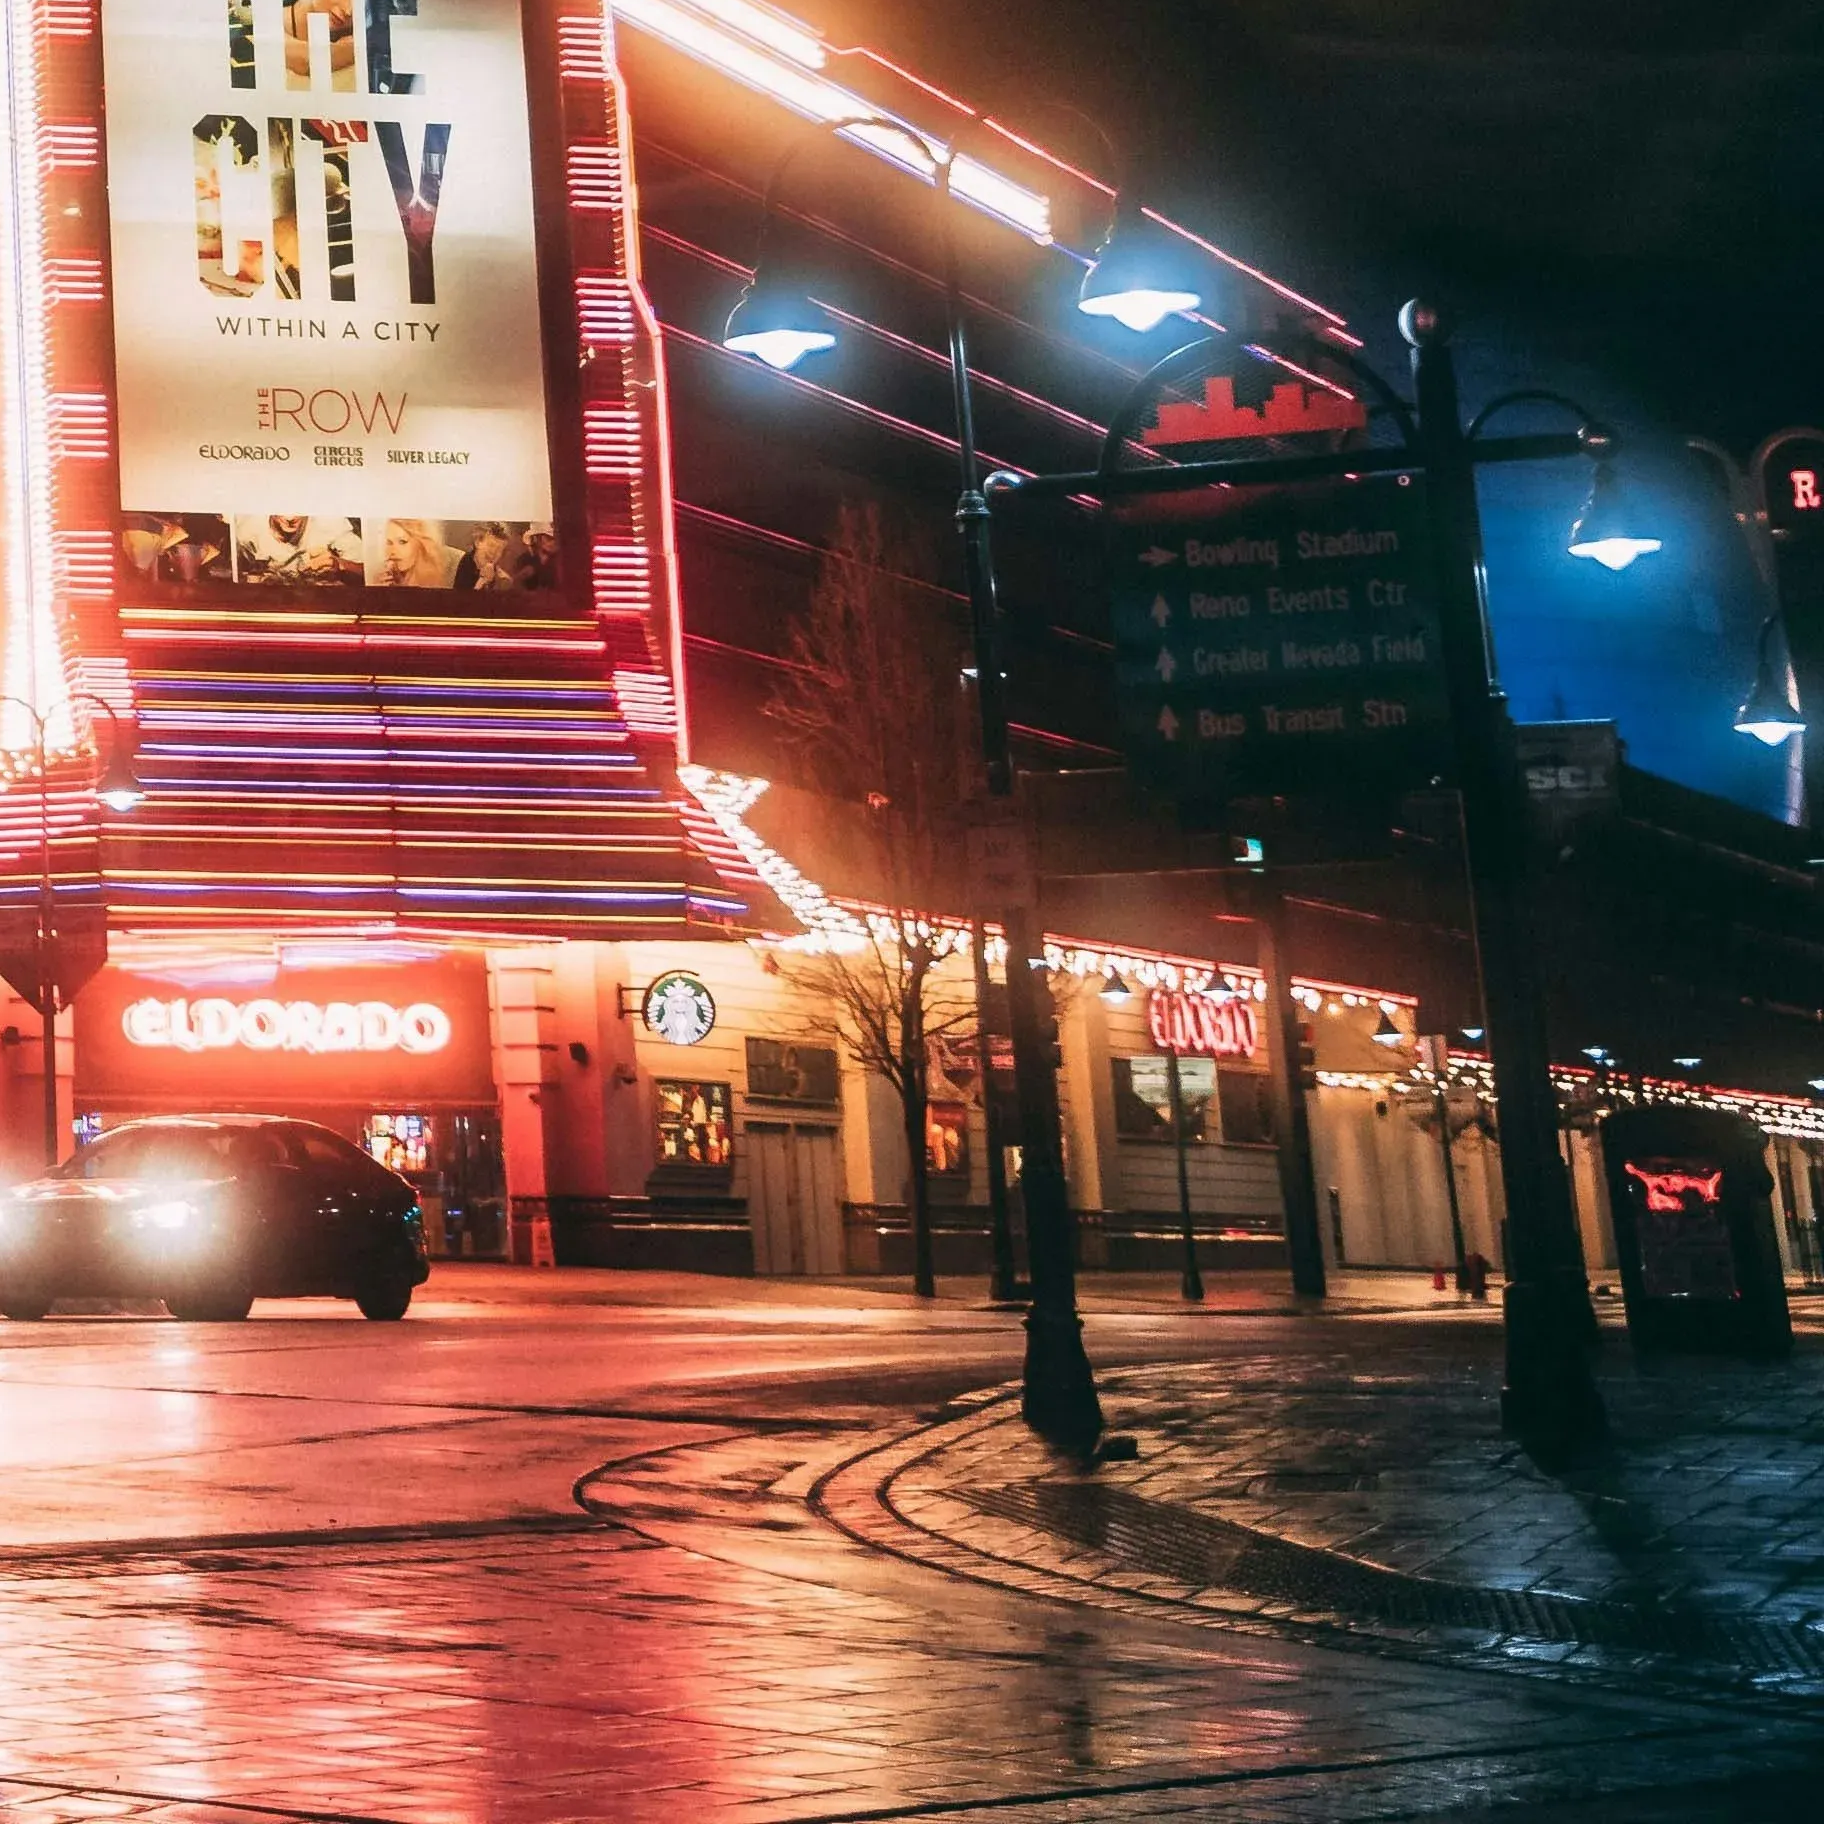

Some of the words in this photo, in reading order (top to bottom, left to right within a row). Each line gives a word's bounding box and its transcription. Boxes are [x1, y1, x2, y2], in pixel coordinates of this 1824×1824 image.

[193, 114, 452, 305] CITY
[216, 316, 326, 339] WITHIN
[342, 322, 359, 339] A
[374, 322, 441, 343] CITY
[257, 388, 270, 430] THE
[271, 388, 408, 435] ROW
[199, 444, 290, 462] ELDORADO
[313, 445, 364, 457] CIRCUS
[314, 456, 364, 467] CIRCUS
[387, 449, 424, 464] SILVER
[428, 452, 470, 465] LEGACY
[1185, 537, 1280, 569] Bowling
[1297, 529, 1399, 559] Stadium
[1190, 593, 1251, 619] Reno
[1267, 585, 1350, 614] Events
[1368, 579, 1407, 607] Ctr
[1193, 646, 1270, 675] Greater
[1281, 640, 1361, 669] Nevada
[1372, 635, 1427, 663] Field
[1198, 709, 1247, 738] Bus
[1262, 704, 1345, 734] Transit
[1363, 698, 1408, 727] Stn
[122, 997, 451, 1054] ELDORADO
